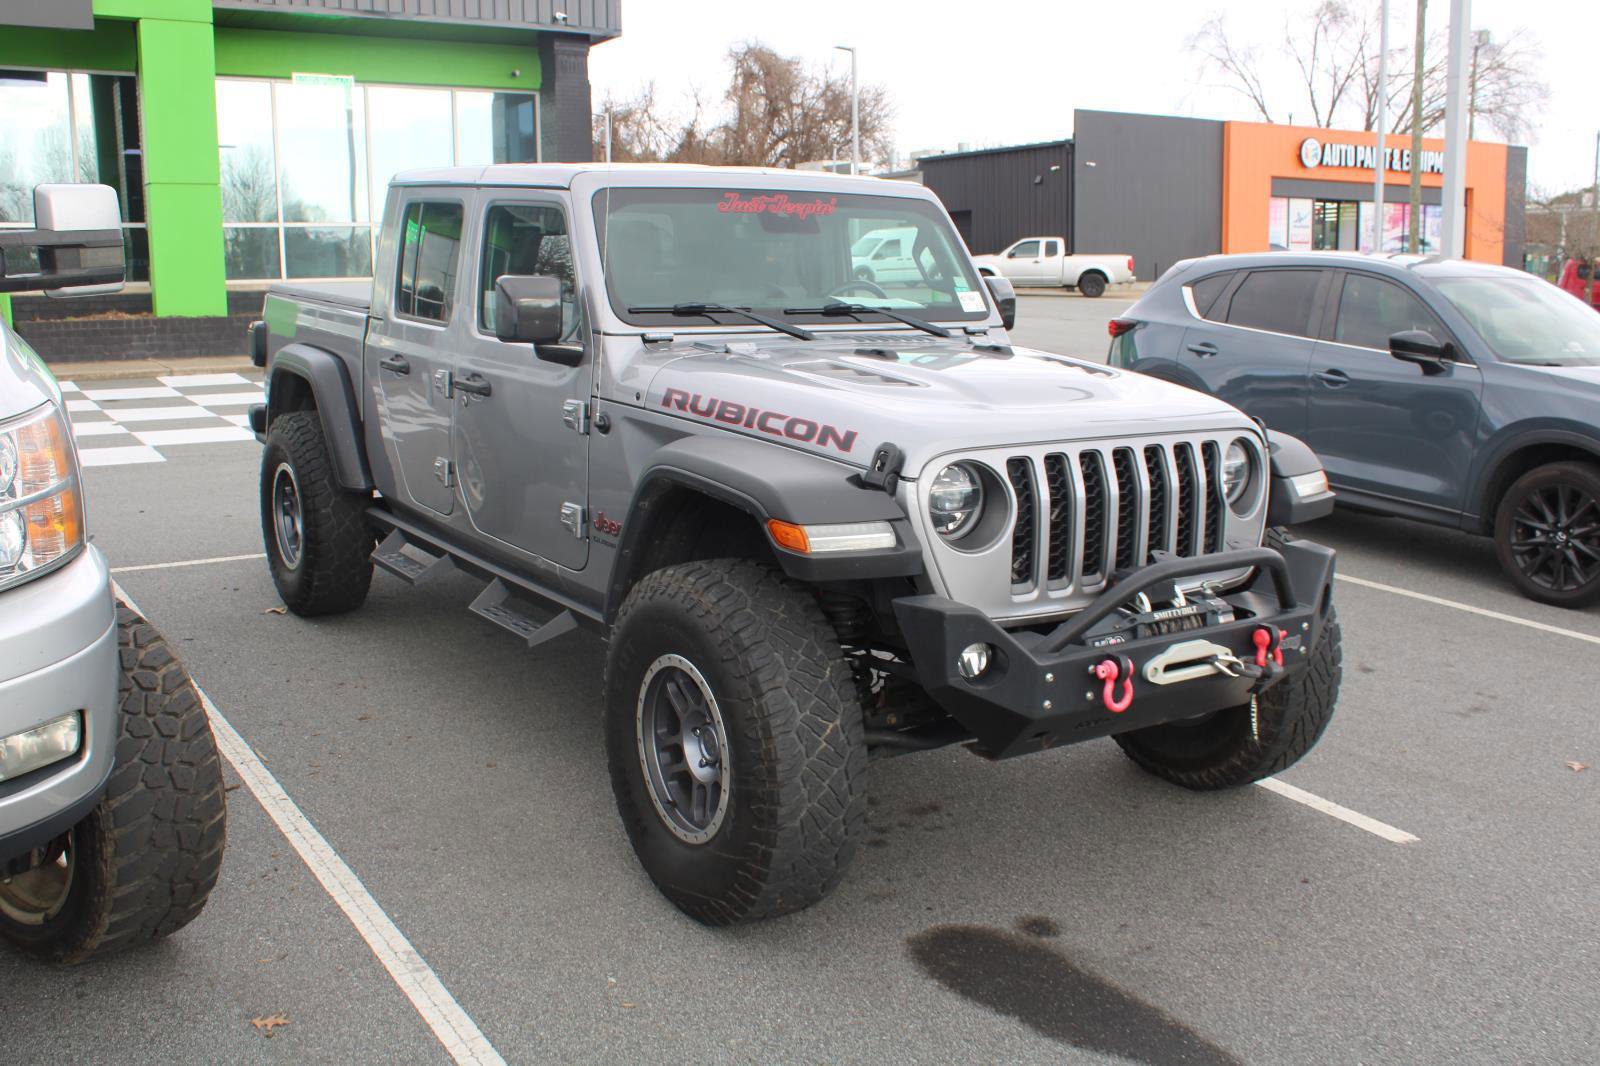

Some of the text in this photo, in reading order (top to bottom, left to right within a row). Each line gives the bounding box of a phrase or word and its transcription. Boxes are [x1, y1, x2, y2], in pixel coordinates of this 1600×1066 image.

[1321, 143, 1356, 166] AUTO
[1356, 145, 1391, 169] PAIT
[1392, 147, 1402, 171] &
[661, 387, 858, 453] RUBICON
